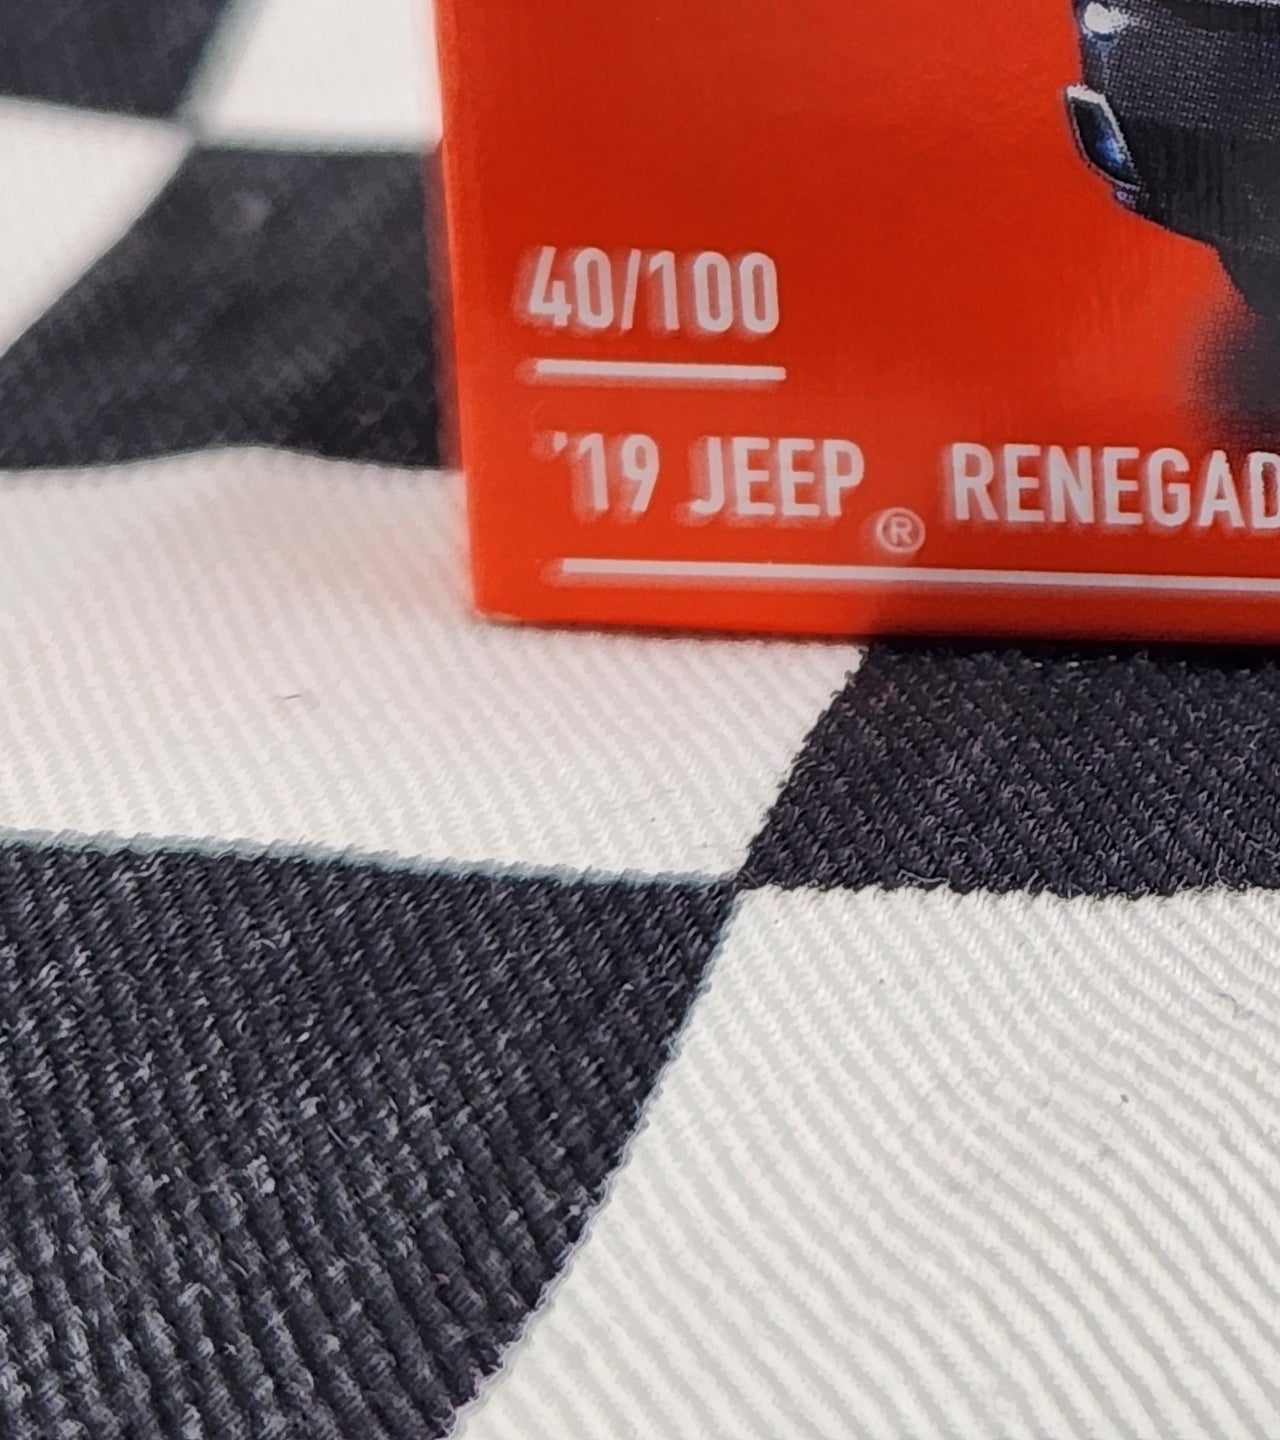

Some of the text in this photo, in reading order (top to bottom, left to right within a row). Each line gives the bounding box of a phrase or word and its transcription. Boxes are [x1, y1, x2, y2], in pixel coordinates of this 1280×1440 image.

[527, 244, 781, 335] 40/100
[551, 430, 660, 513] '19
[688, 435, 865, 518] JEEP
